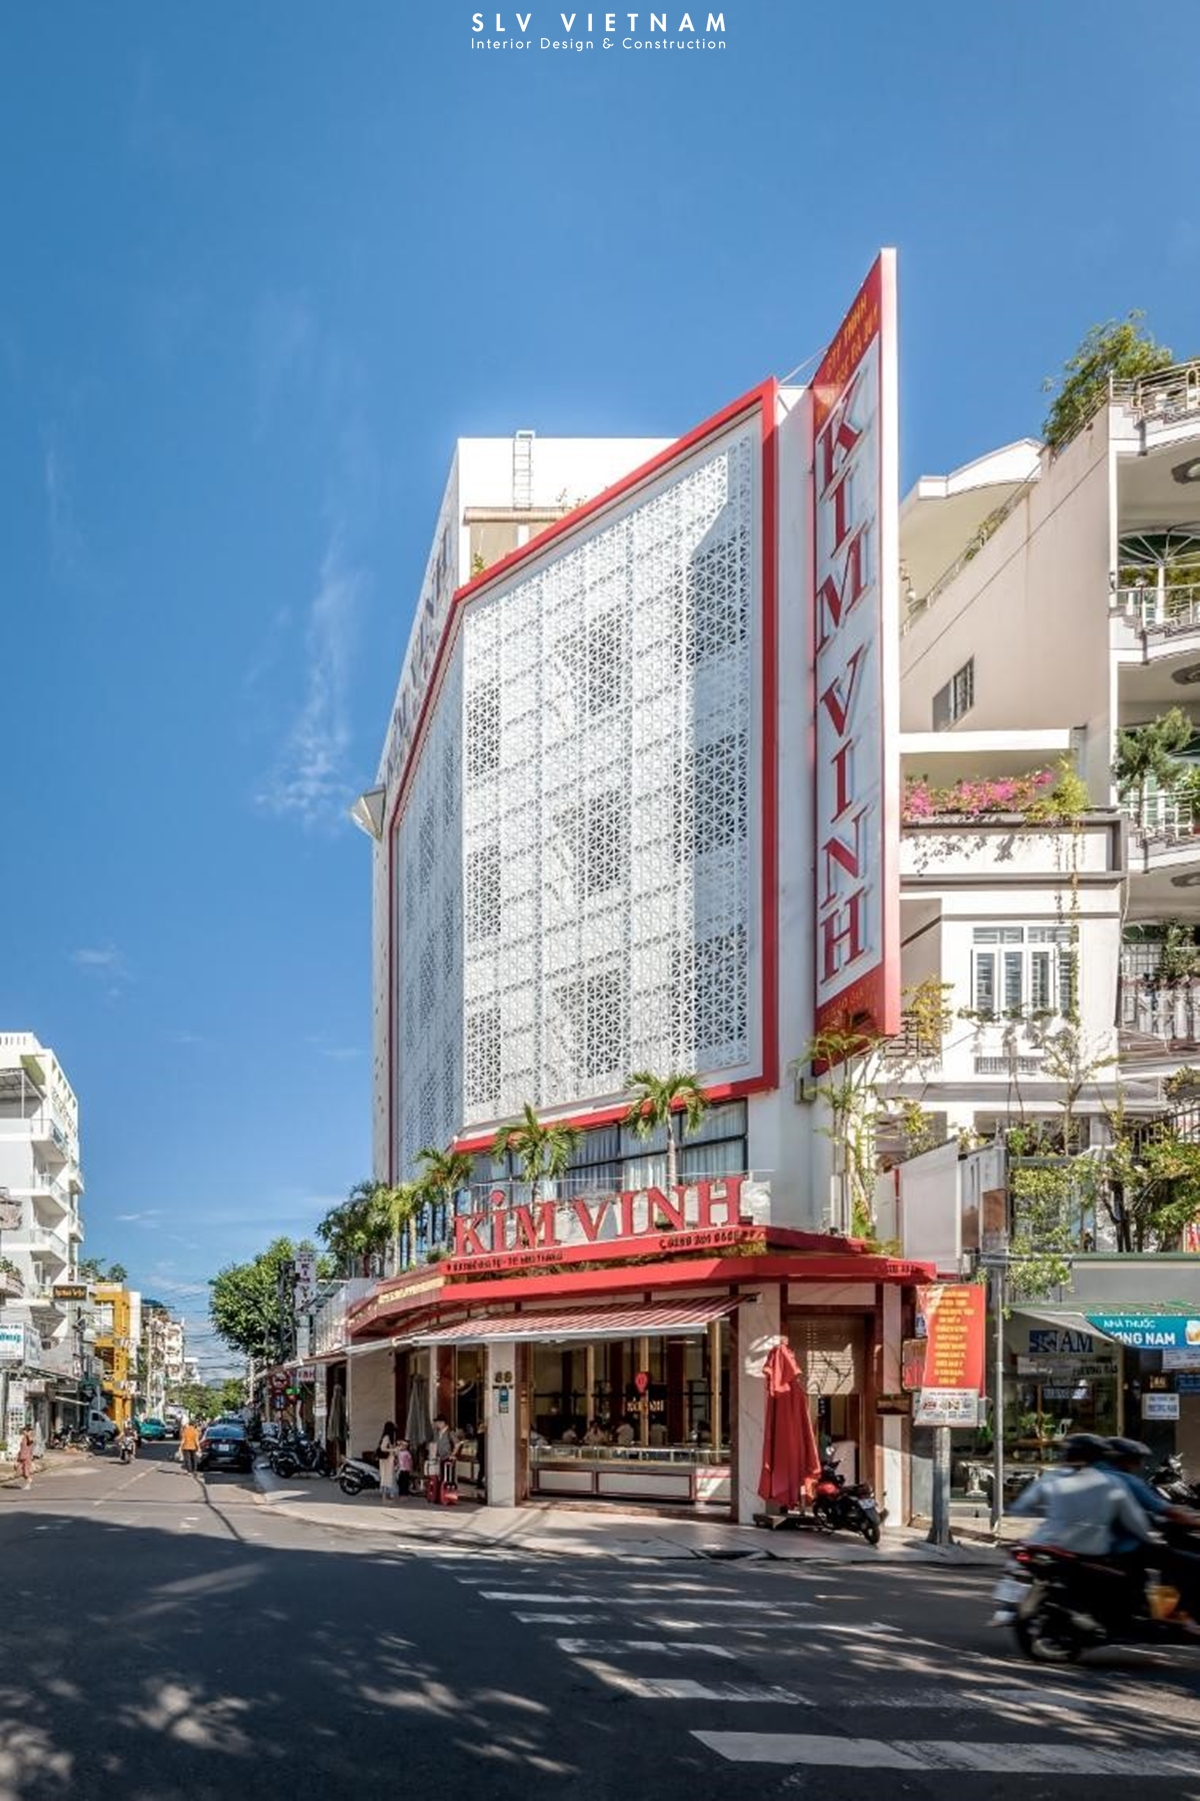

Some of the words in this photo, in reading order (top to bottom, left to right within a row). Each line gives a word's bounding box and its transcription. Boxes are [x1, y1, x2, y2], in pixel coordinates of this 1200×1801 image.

[819, 644, 873, 986] VINH
[571, 1176, 748, 1243] VINH
[1146, 1332, 1176, 1346] NAM
